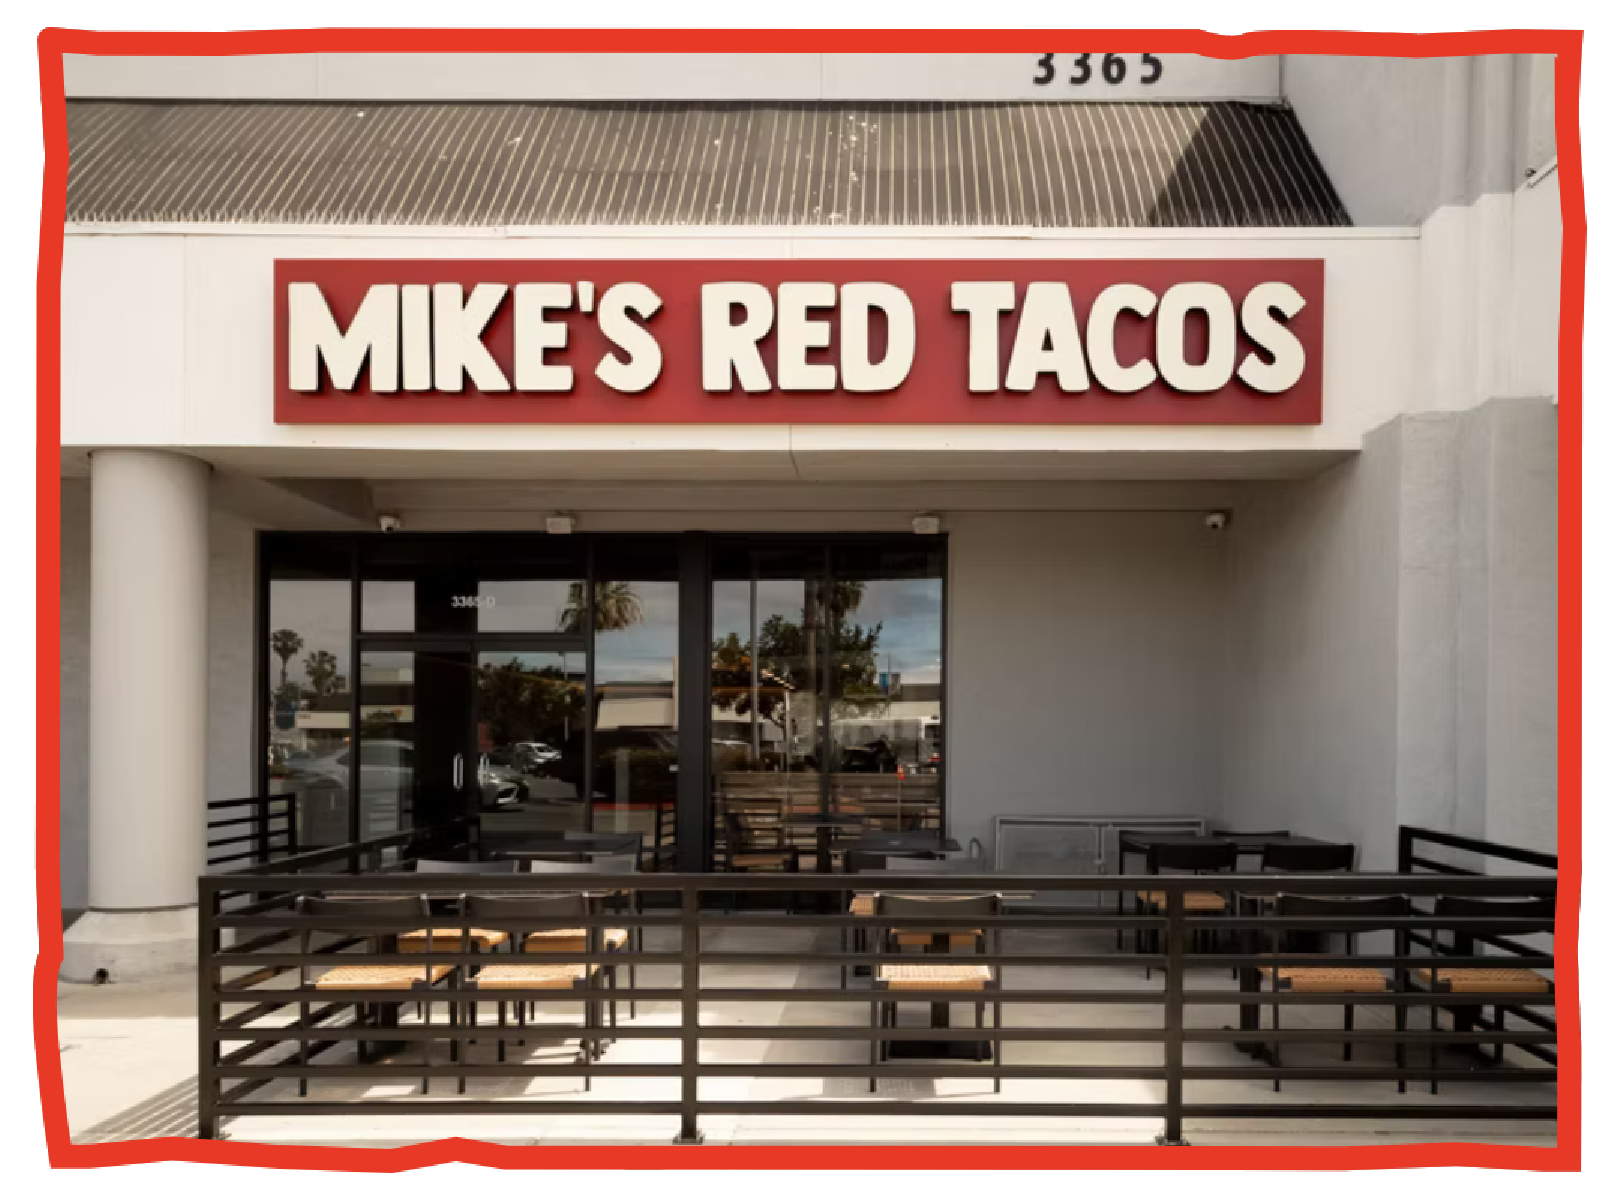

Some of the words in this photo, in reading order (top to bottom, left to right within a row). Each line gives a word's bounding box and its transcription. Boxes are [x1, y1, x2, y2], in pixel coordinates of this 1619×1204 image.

[1032, 53, 1162, 85] 3365
[287, 280, 663, 392] MIKE'S
[701, 280, 916, 392] RED
[950, 280, 1307, 393] TACOS
